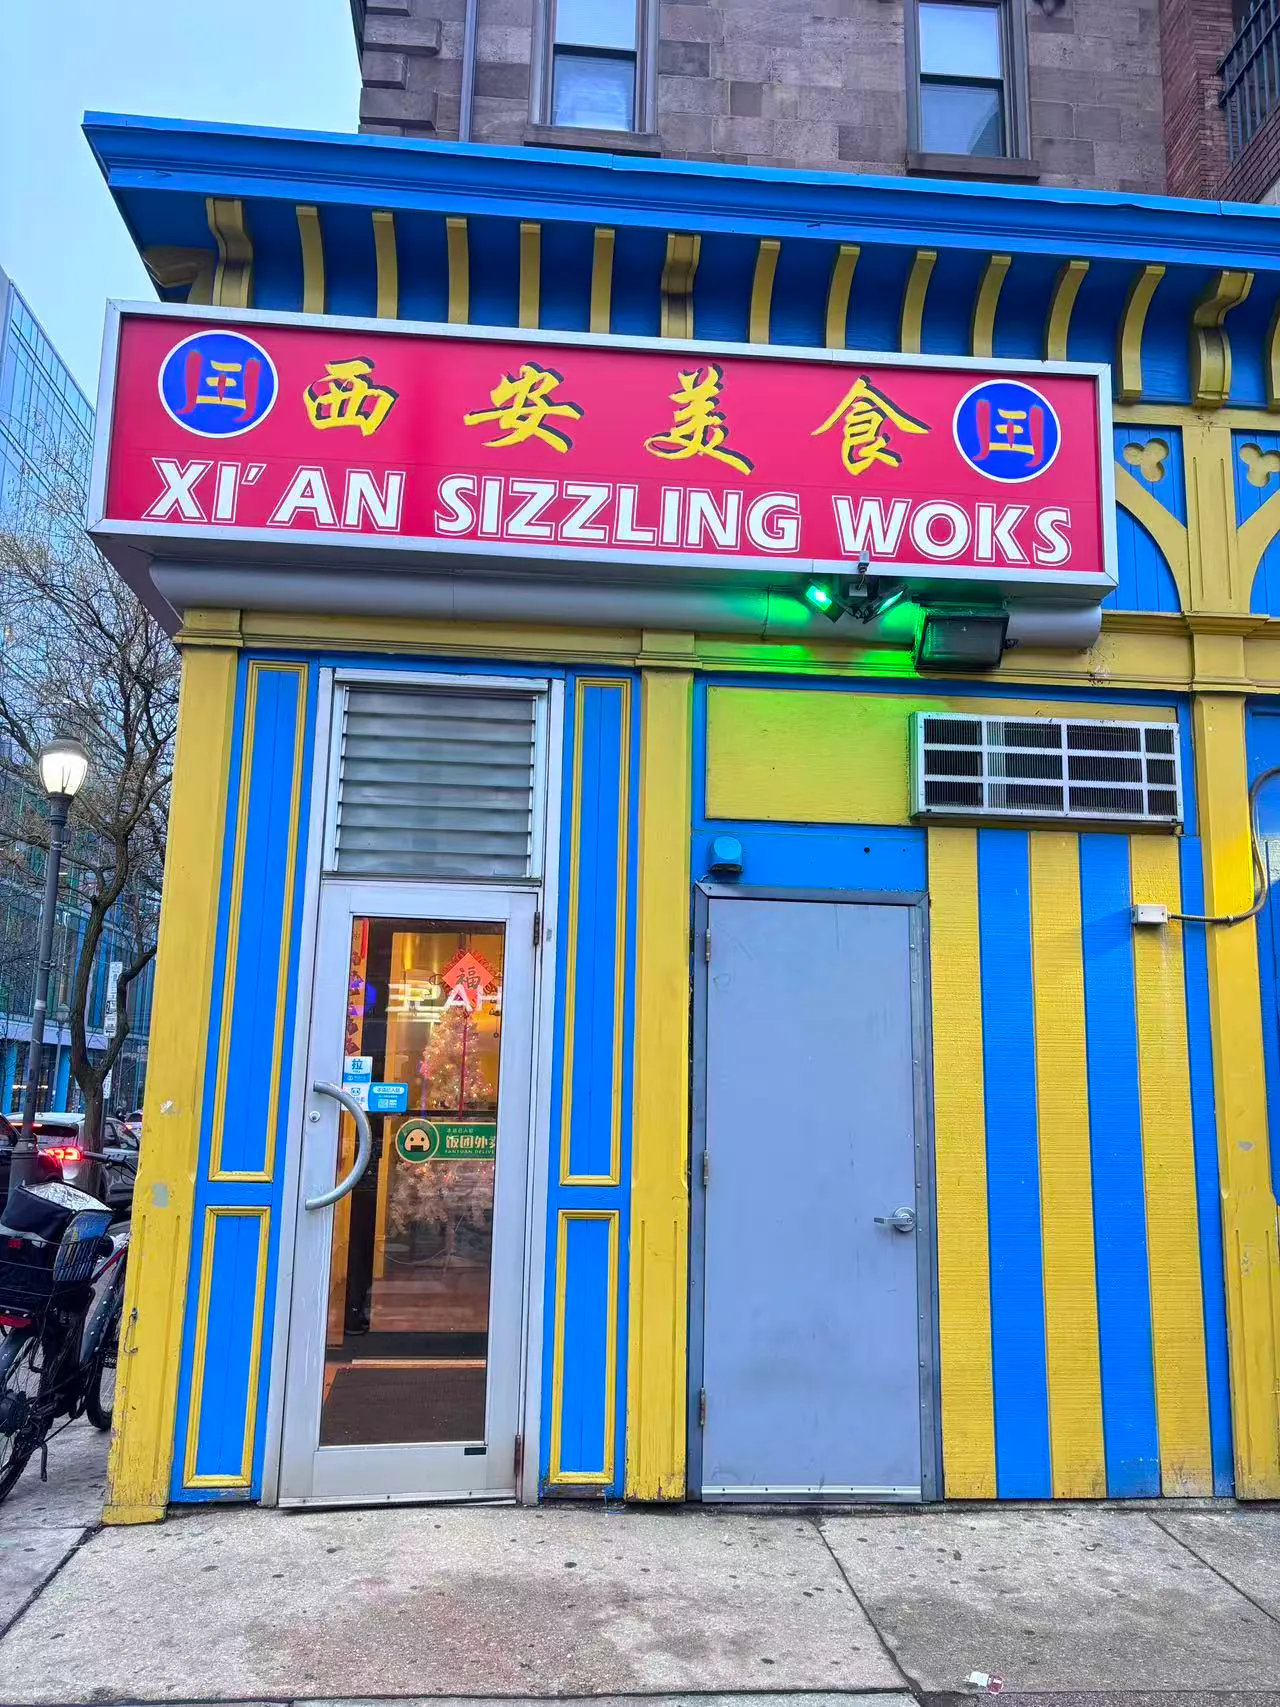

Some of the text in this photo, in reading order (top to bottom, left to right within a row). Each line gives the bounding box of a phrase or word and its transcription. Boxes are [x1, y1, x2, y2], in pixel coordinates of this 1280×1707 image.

[303, 355, 930, 476] 西安美食
[433, 473, 802, 553] SIZZLING
[831, 494, 1073, 566] WOKS
